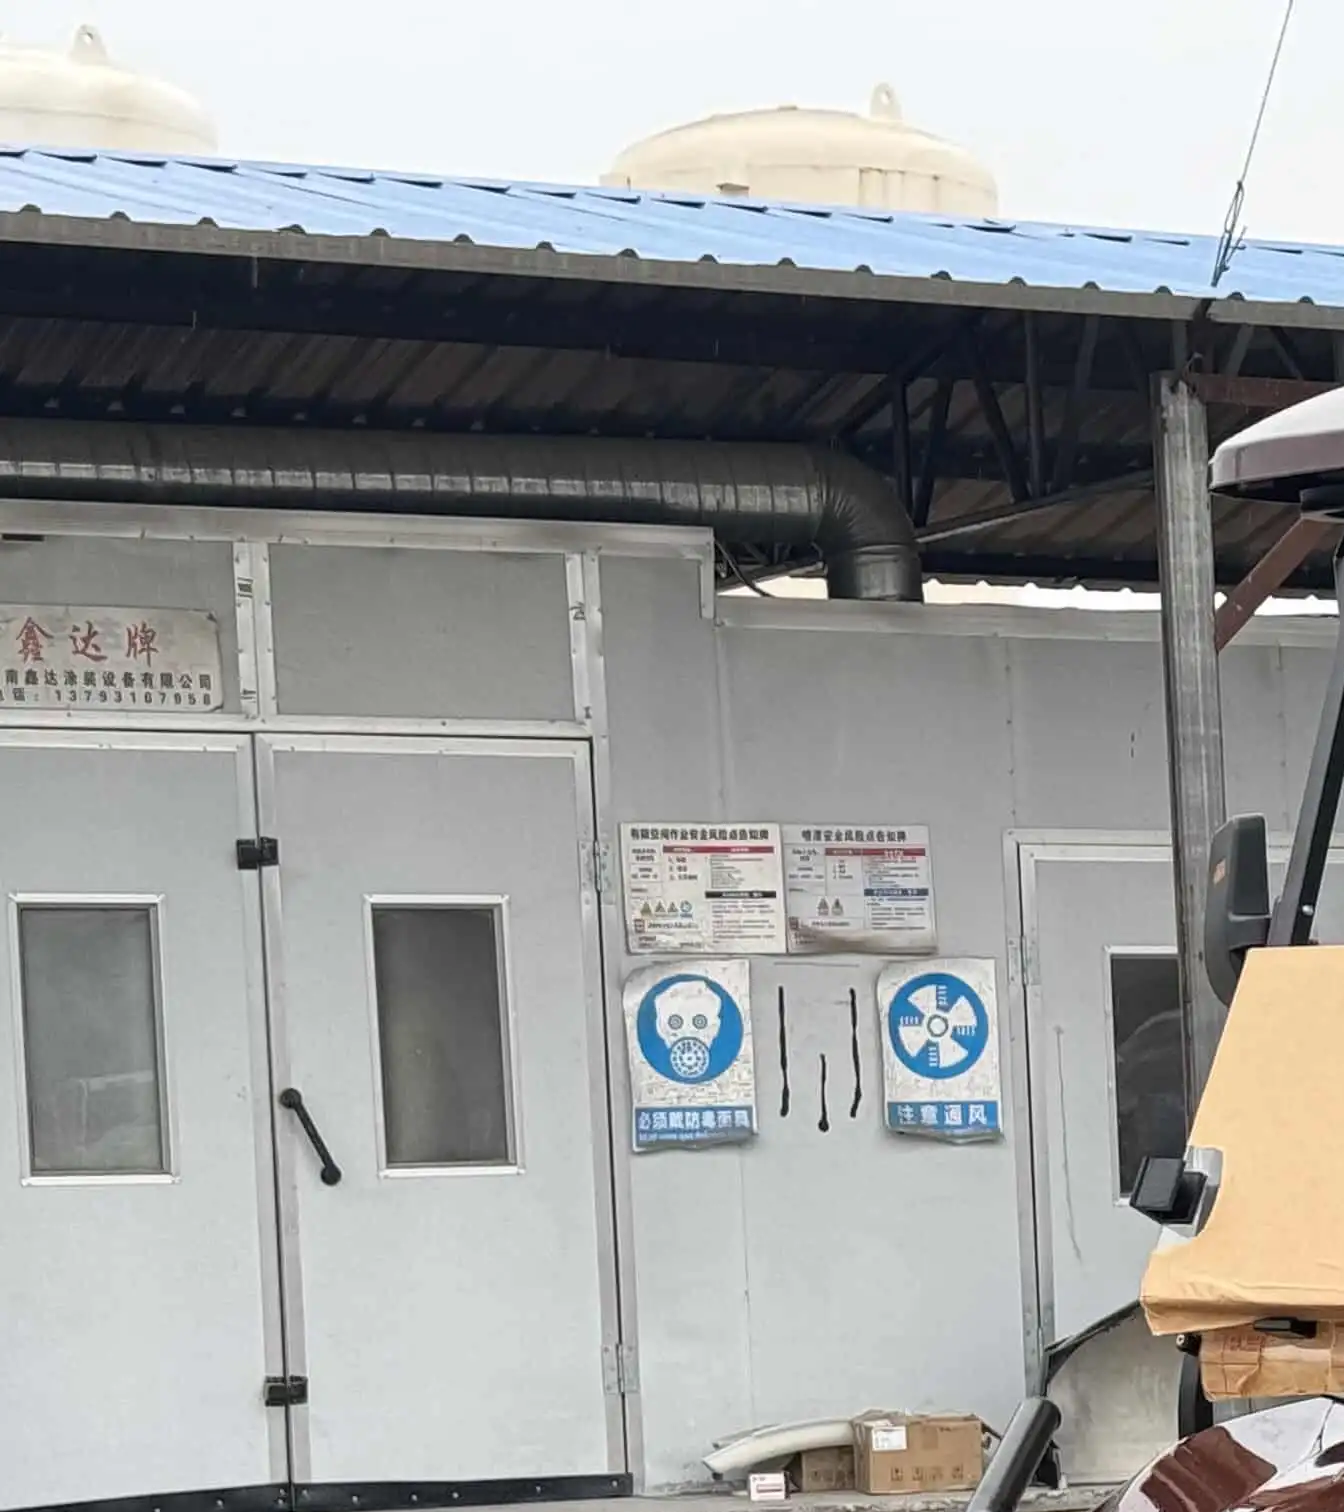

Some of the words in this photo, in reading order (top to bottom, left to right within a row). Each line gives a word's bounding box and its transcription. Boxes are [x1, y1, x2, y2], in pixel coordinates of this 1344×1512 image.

[16, 616, 159, 667] 鑫达牌
[897, 1104, 987, 1125] 注意通风
